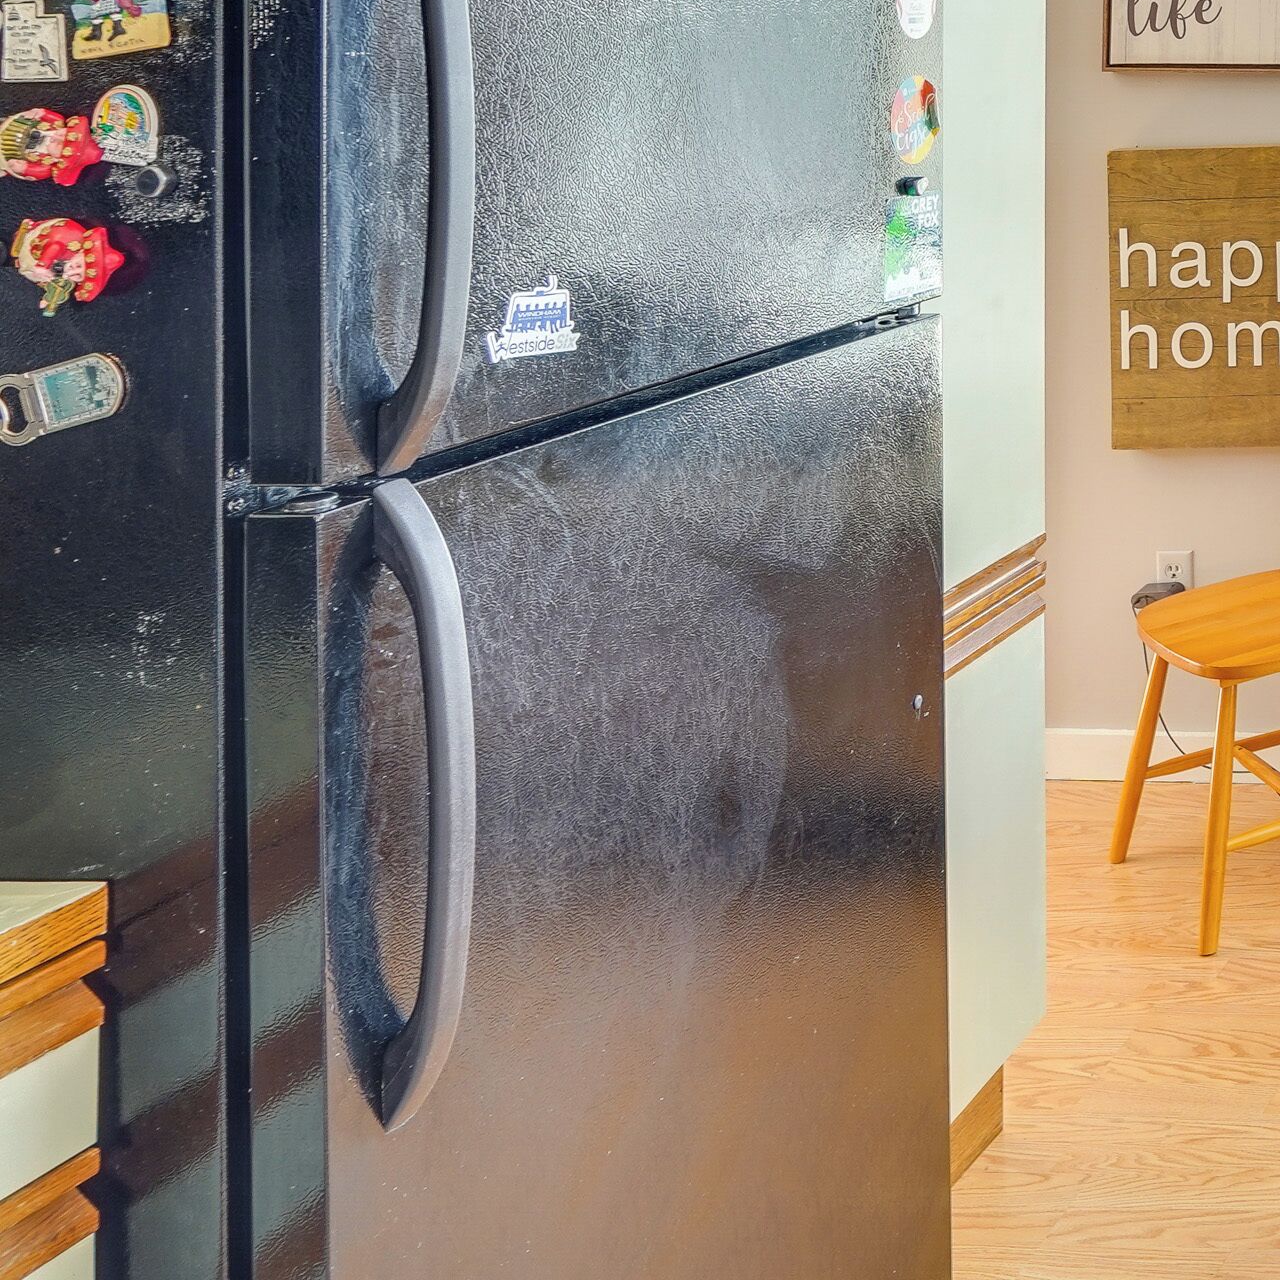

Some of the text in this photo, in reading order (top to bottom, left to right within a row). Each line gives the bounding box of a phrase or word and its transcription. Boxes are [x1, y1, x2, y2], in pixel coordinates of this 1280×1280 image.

[911, 194, 940, 210] GREY
[918, 211, 940, 228] FOX
[517, 309, 562, 318] WINDHAM
